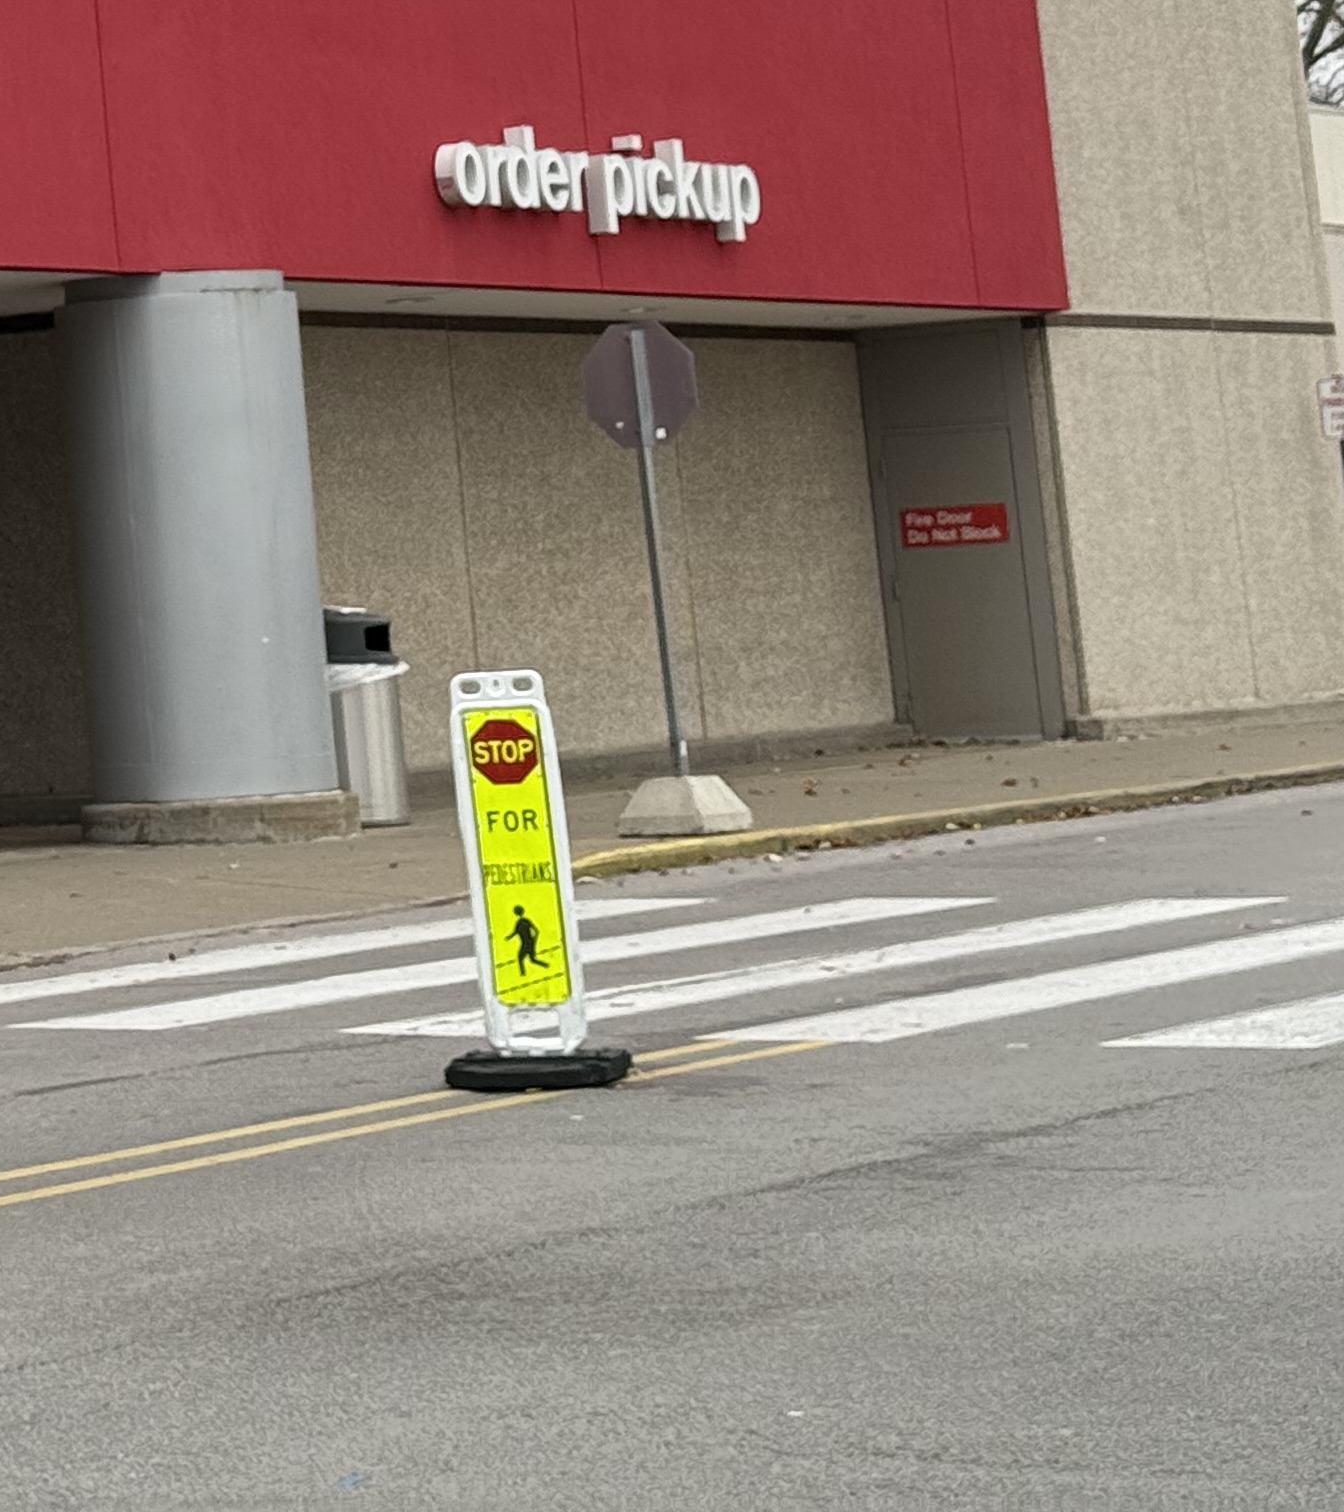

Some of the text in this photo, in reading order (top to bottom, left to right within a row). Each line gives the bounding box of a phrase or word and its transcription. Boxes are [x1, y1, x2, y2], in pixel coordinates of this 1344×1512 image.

[435, 125, 761, 242] order pickup
[473, 738, 534, 765] STOP
[486, 809, 539, 832] FOR
